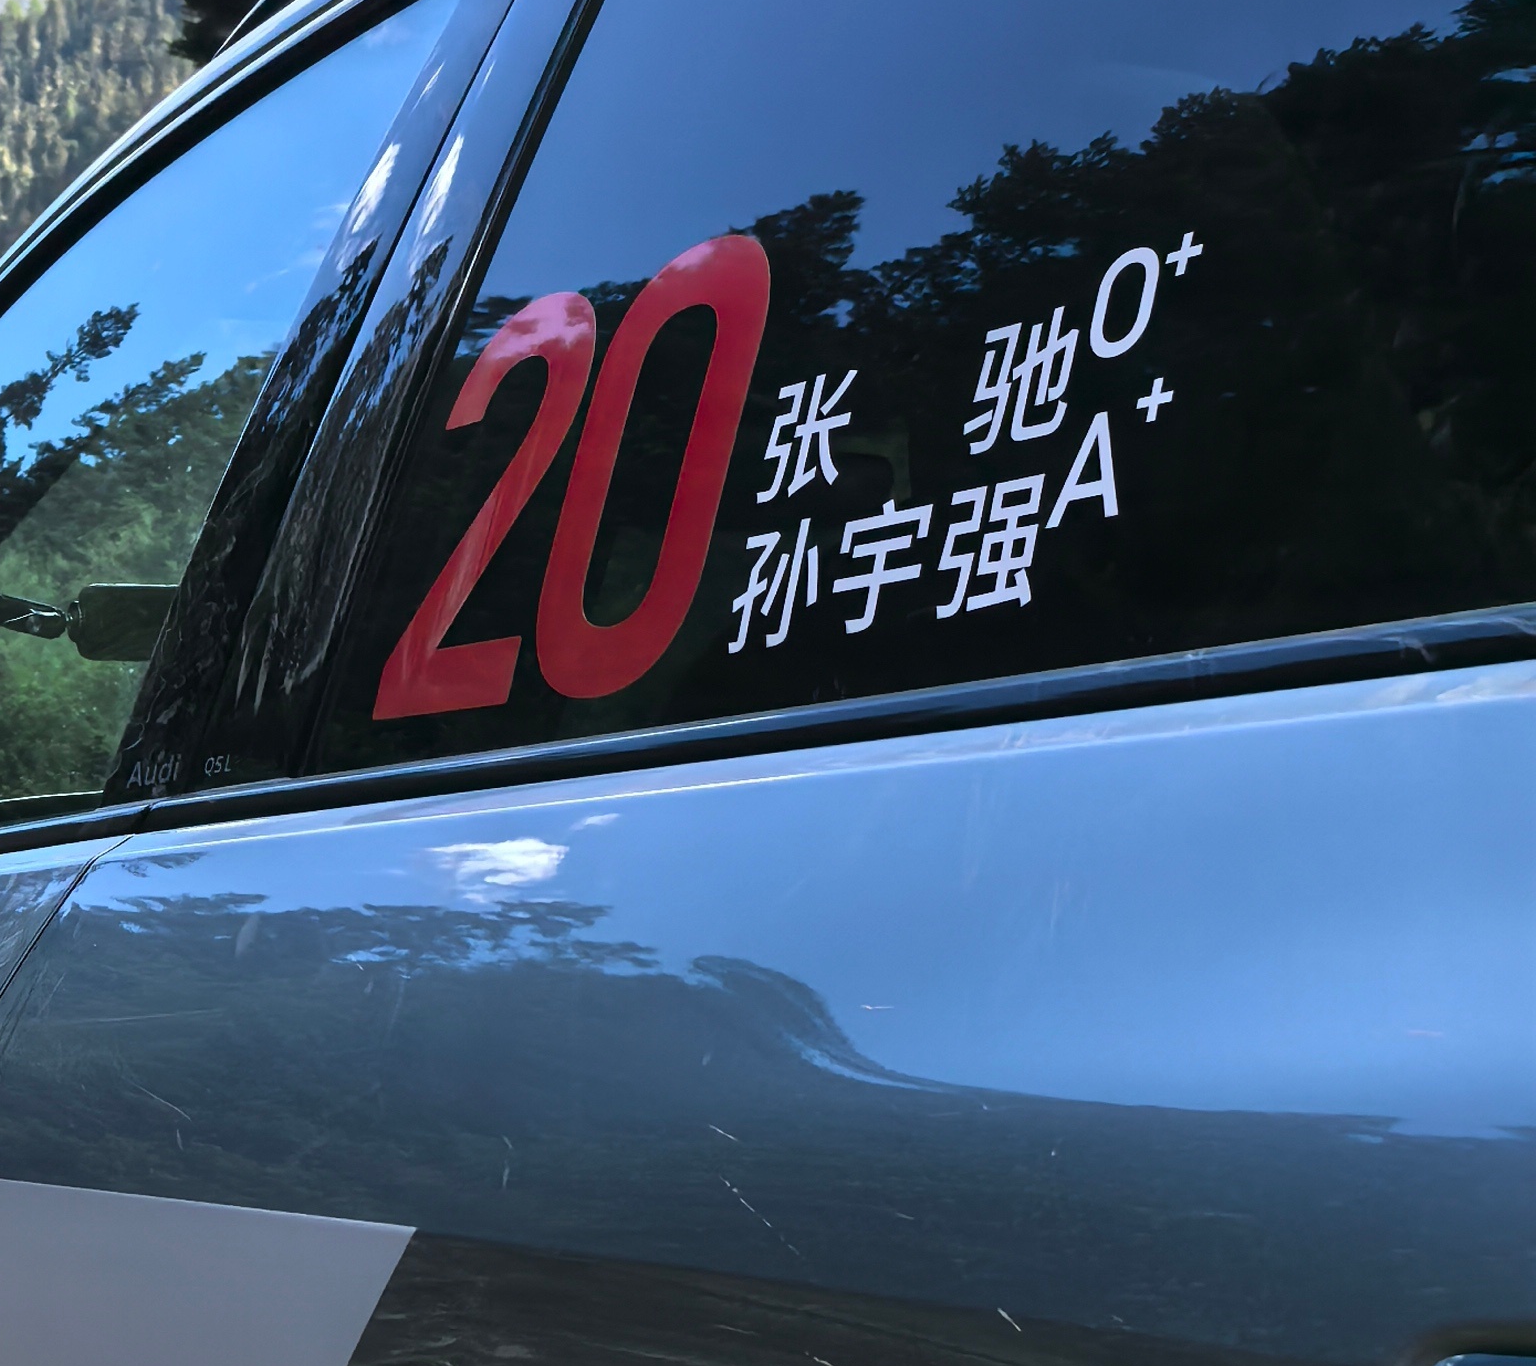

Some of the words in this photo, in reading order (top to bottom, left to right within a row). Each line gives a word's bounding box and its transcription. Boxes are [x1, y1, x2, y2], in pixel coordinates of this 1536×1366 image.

[372, 234, 772, 720] 20
[756, 369, 858, 504] 张
[963, 305, 1080, 455] 驰
[727, 473, 1046, 654] 孙宇强
[125, 753, 182, 789] Audi
[204, 753, 232, 777] Q5L
